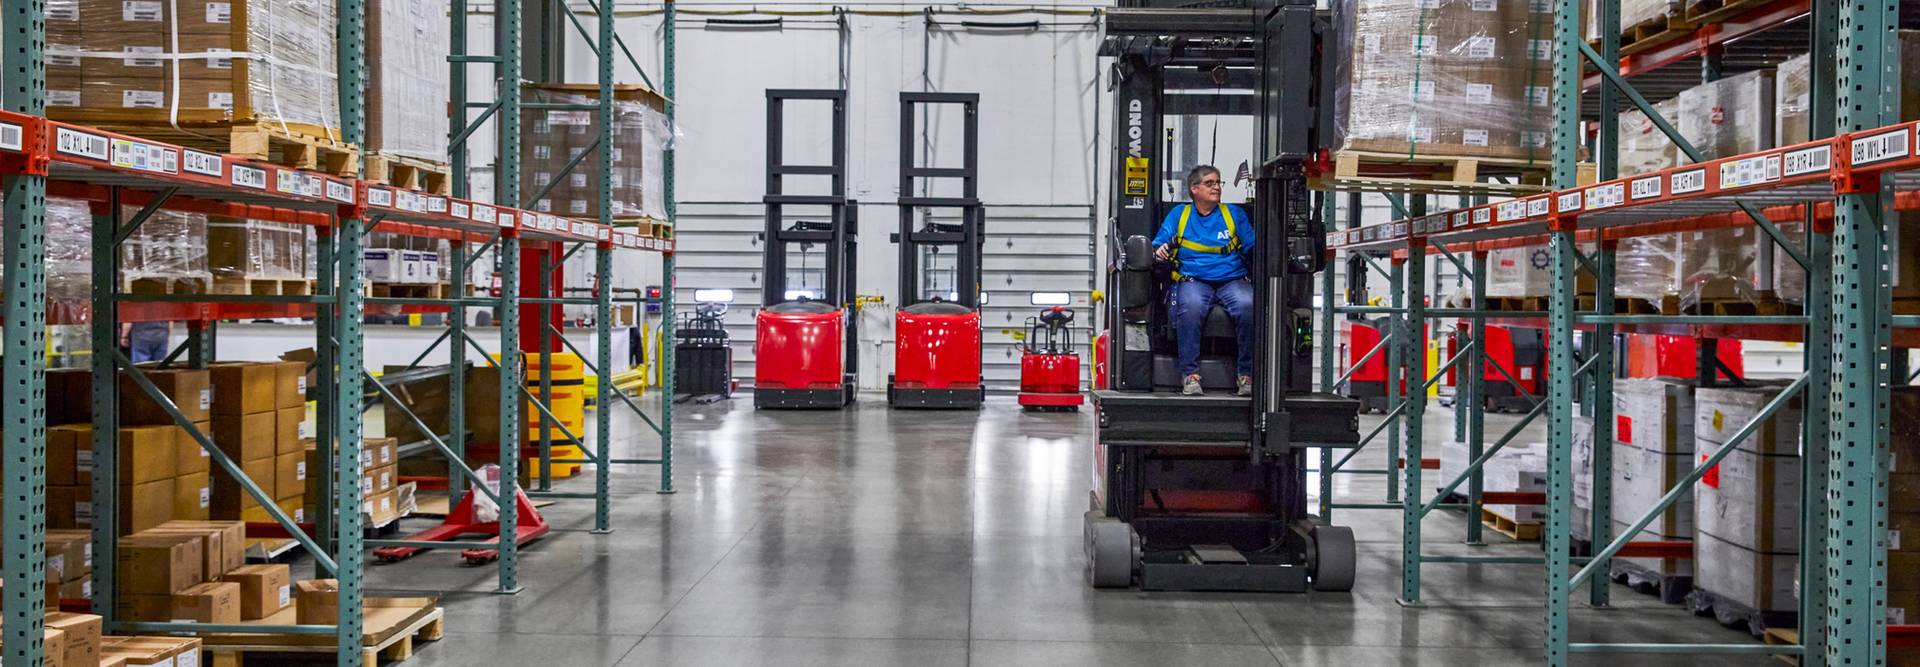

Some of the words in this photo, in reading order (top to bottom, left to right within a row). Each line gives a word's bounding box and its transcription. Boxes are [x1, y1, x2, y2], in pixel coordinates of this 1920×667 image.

[1128, 99, 1142, 159] MOND
[61, 132, 70, 150] 102
[73, 135, 83, 153] X1L
[1853, 143, 1865, 162] 098
[1867, 139, 1881, 159] W1L
[1786, 156, 1795, 173] 098
[1796, 153, 1807, 171] X1R
